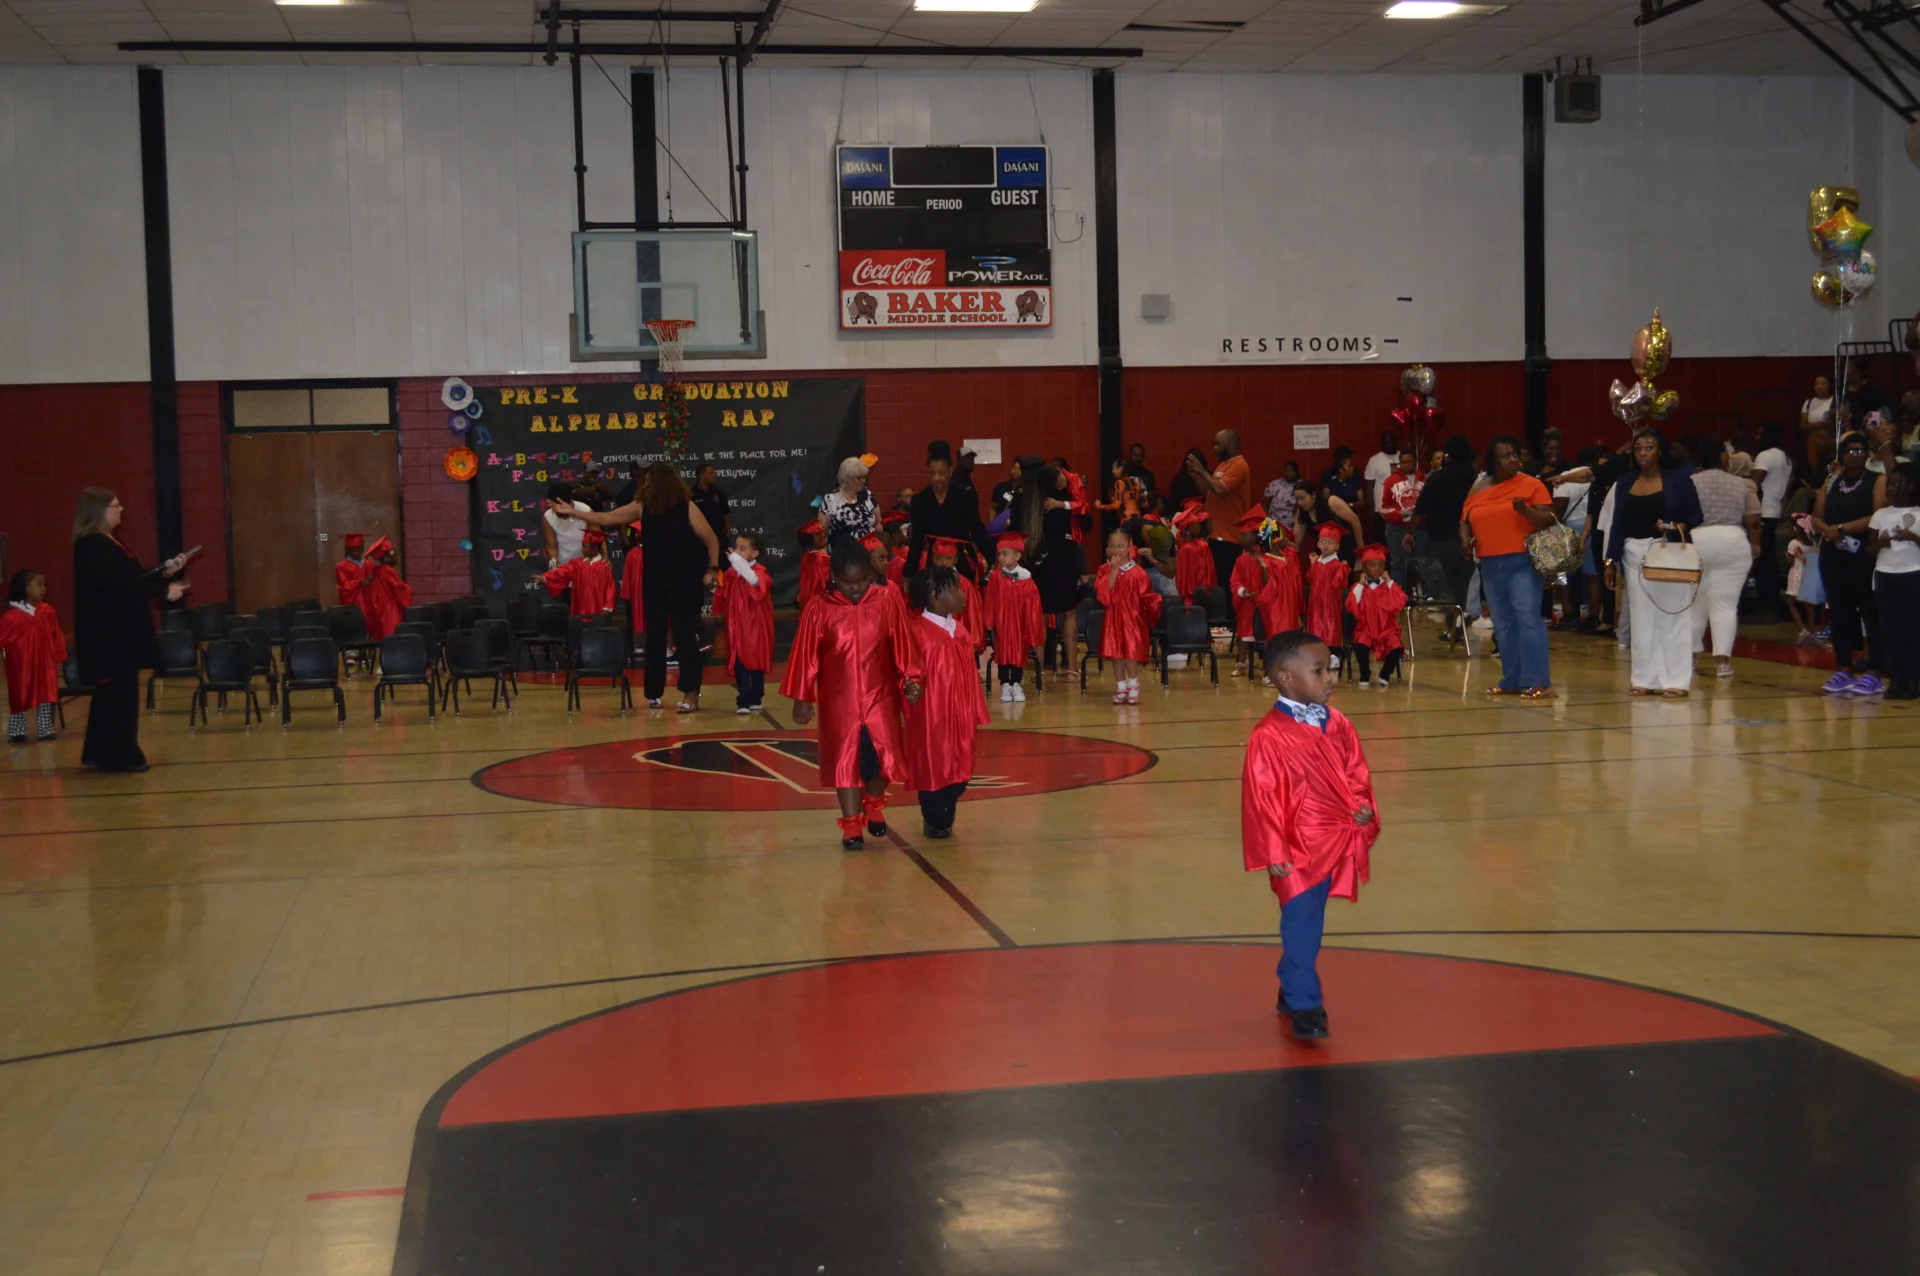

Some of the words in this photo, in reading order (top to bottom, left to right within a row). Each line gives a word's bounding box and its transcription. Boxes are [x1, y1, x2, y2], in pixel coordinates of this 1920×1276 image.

[847, 162, 882, 173] DASANI
[1004, 162, 1039, 173] DASANI
[852, 190, 895, 206] HOME
[991, 190, 1038, 205] GUEST
[926, 199, 963, 209] PERIOD
[887, 291, 1005, 313] BAKER
[887, 314, 946, 324] MIDDLE
[950, 313, 1007, 323] SCHOOL
[1222, 337, 1372, 352] RESTROOMS
[500, 386, 578, 405] PRE-K
[633, 381, 789, 400] GRDUATION
[721, 408, 775, 428] RAP
[704, 451, 715, 460] BE
[719, 450, 735, 459] THE
[740, 450, 765, 459] PLACE
[769, 449, 786, 458] FOR
[791, 448, 807, 457] ME!
[618, 471, 632, 480] WE
[714, 469, 757, 479] VERYDAY.
[741, 499, 756, 507] GO!
[766, 547, 786, 558] TRY.
